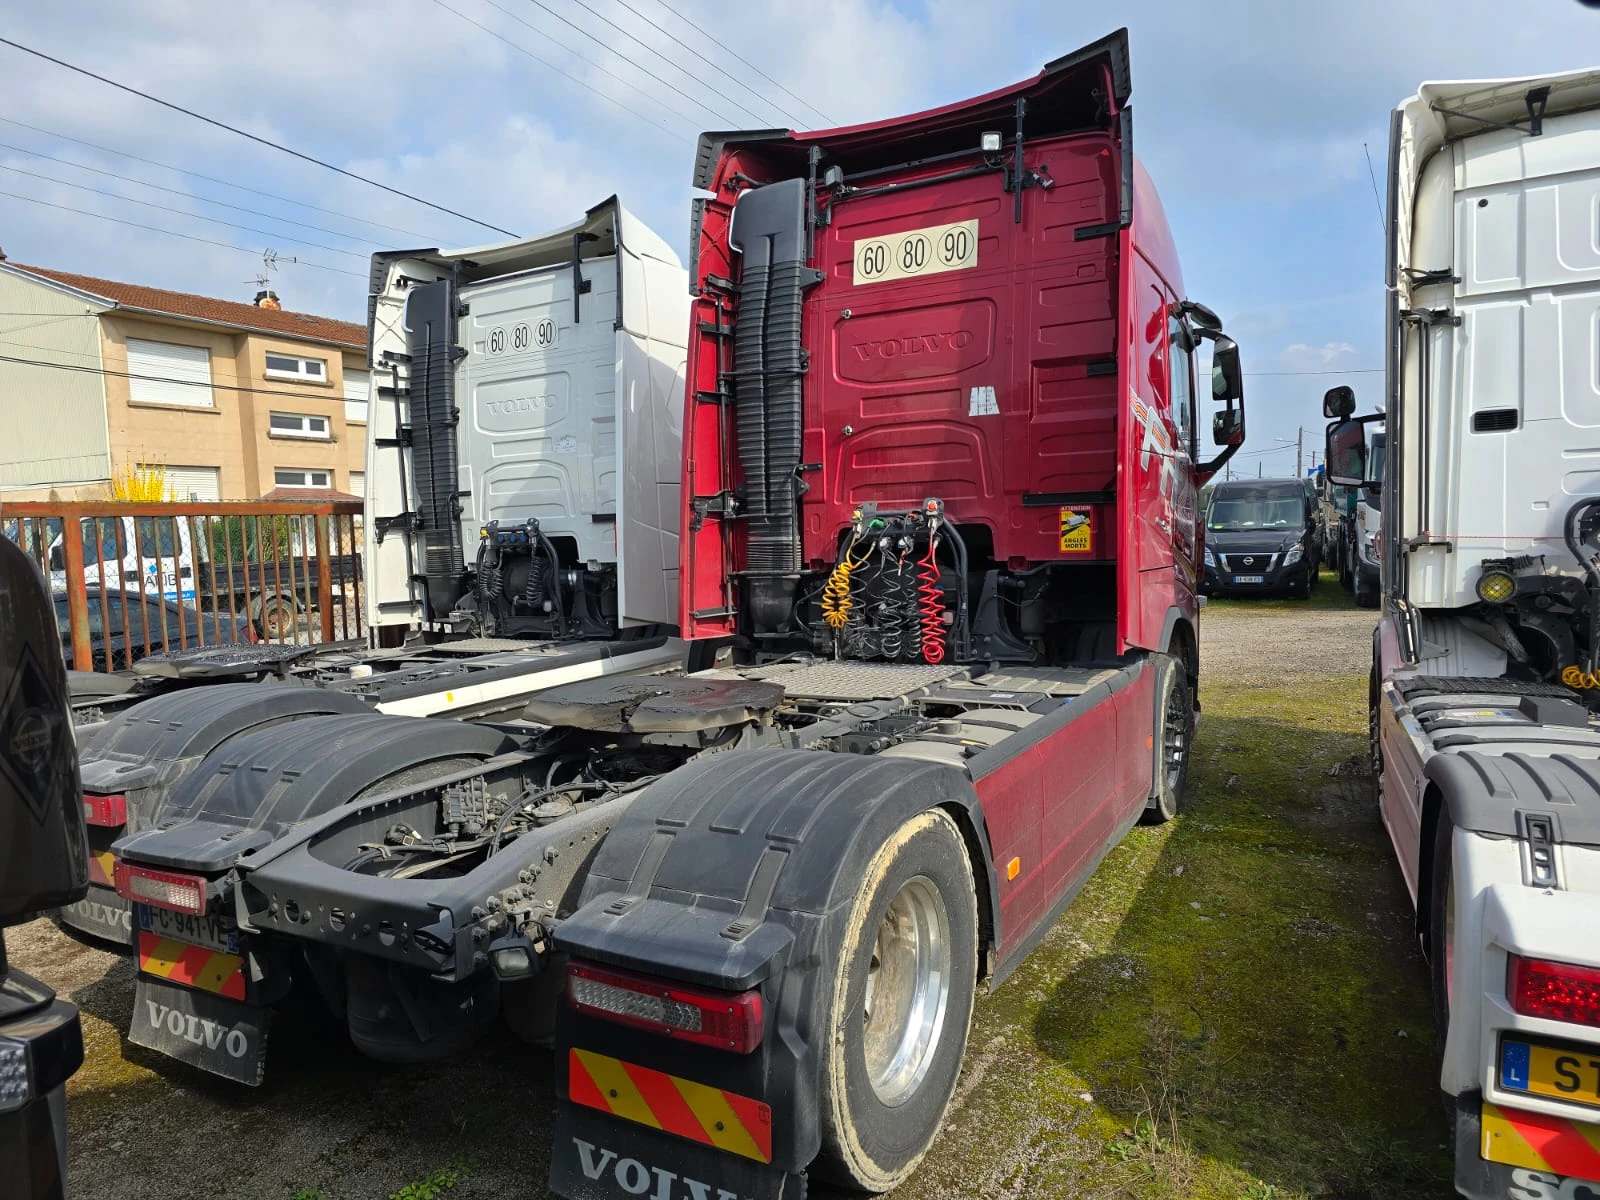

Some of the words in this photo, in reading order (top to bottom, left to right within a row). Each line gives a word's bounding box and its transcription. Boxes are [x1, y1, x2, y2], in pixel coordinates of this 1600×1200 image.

[863, 245, 885, 275] 60
[903, 238, 925, 269] 80
[944, 231, 967, 262] 90
[491, 330, 504, 352] 60
[514, 326, 528, 349] 80
[538, 322, 552, 345] 90
[852, 330, 975, 361] VOLVO
[485, 394, 558, 417] VOLVO
[146, 999, 248, 1058] VOLVO
[1510, 1068, 1520, 1082] L
[572, 1136, 752, 1200] VOLV
